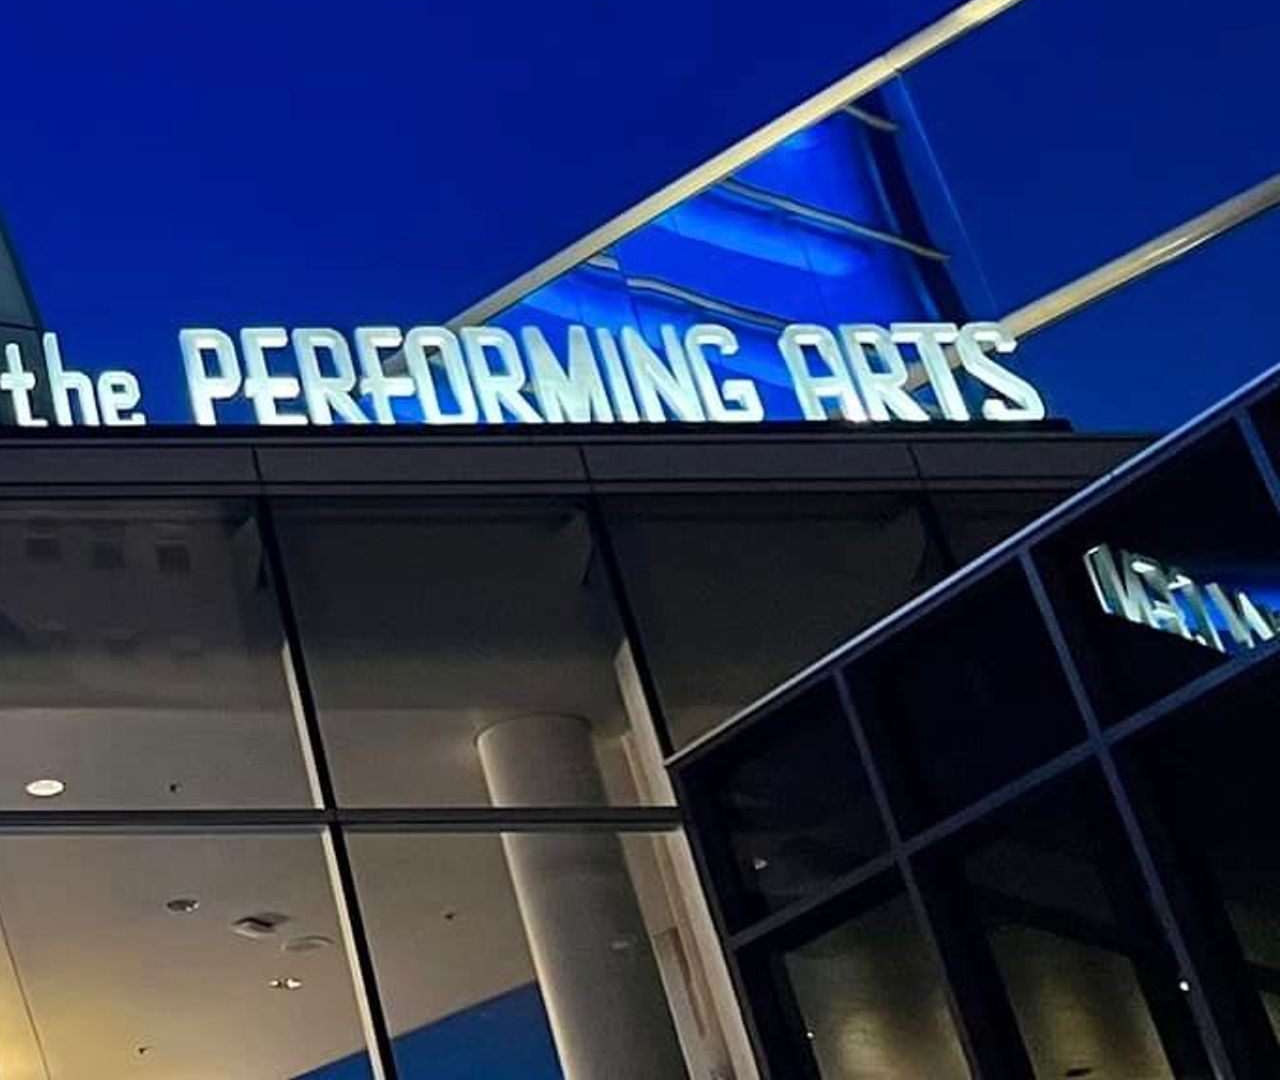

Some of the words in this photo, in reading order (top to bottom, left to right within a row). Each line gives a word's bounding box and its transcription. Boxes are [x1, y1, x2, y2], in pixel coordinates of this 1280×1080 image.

[0, 332, 146, 427] the
[179, 325, 764, 426] PERFORMING
[783, 322, 1046, 422] ARTS
